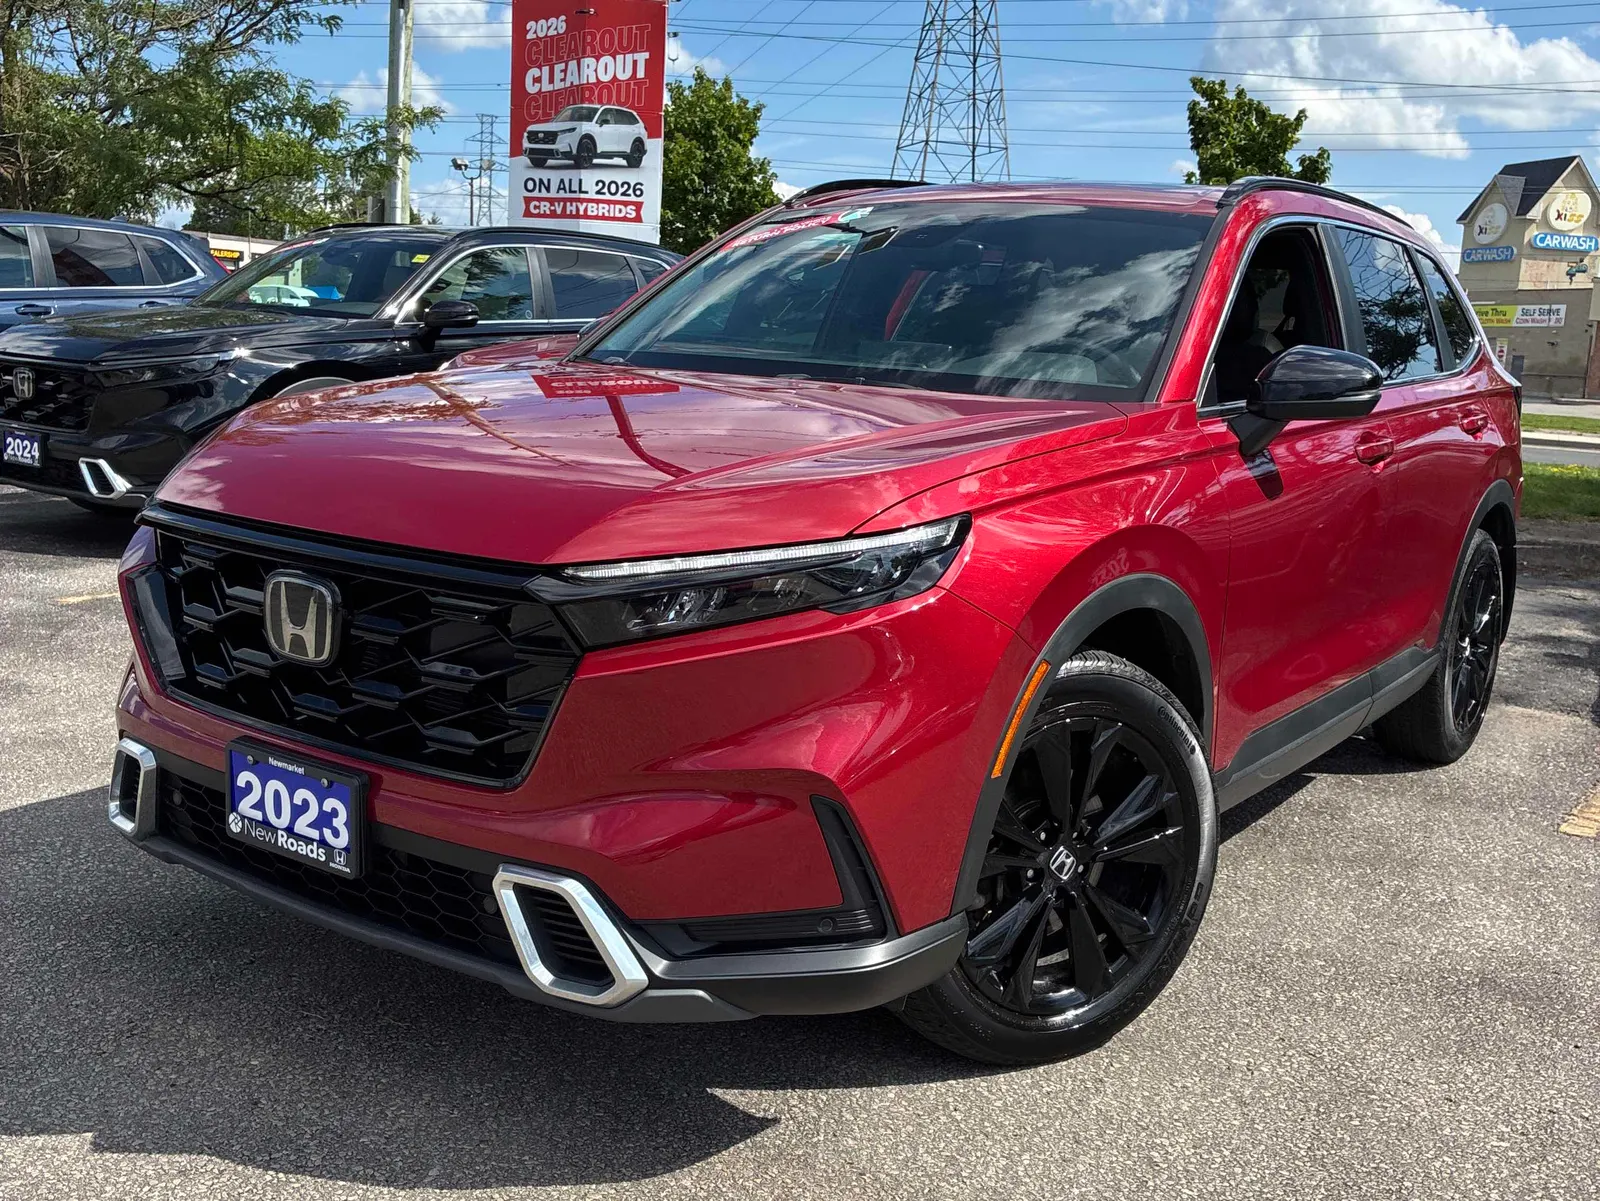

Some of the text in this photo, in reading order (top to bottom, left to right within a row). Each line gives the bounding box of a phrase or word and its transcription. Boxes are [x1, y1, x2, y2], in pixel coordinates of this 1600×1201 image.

[526, 15, 567, 40] 2026
[525, 24, 651, 67] CLEAROUT
[525, 52, 650, 94] CLEAROUT
[523, 177, 644, 198] ON ALL 2026
[529, 200, 637, 219] CR-V HYBRIDS
[1536, 233, 1596, 251] CARWASH
[1464, 247, 1512, 262] CARWASH
[1475, 307, 1507, 317] rive Thru
[1520, 307, 1561, 317] SELF SERVE
[6, 437, 39, 459] 2024
[1157, 706, 1193, 749] Continental
[268, 756, 305, 775] Newmarket
[236, 770, 349, 849] 2023
[329, 862, 351, 874] HONDA
